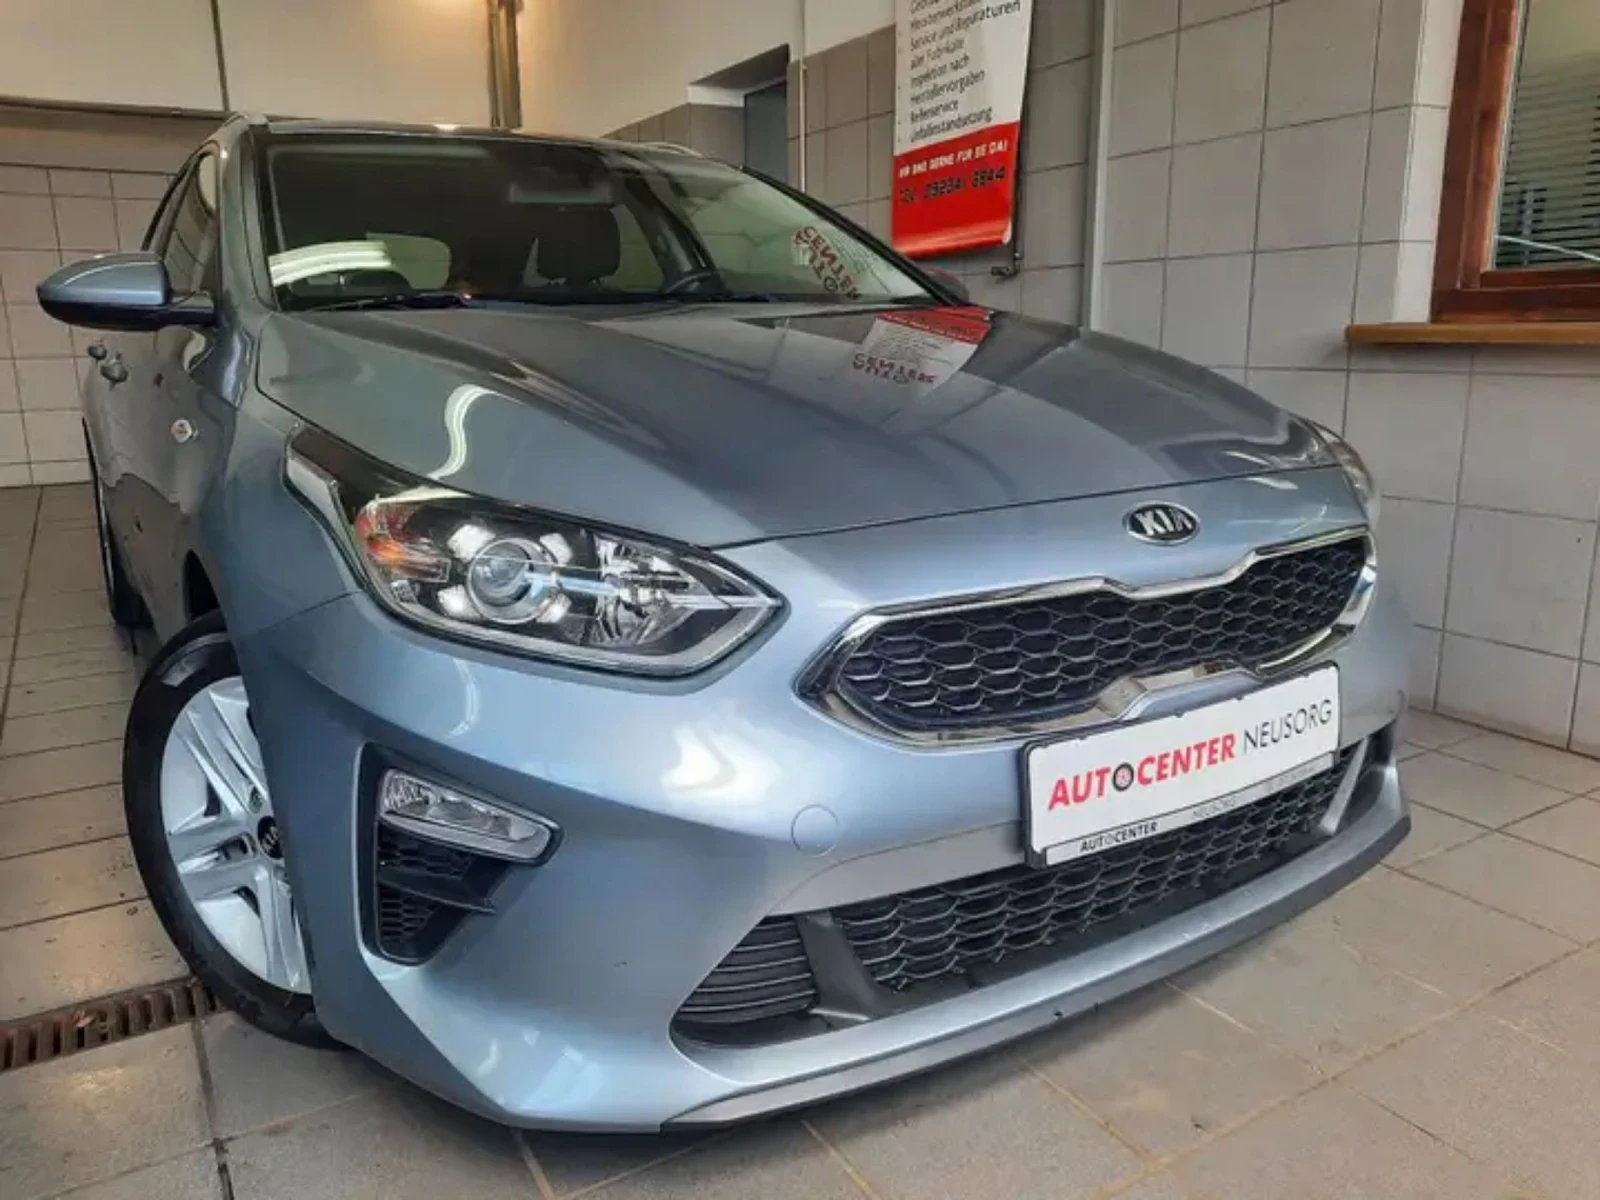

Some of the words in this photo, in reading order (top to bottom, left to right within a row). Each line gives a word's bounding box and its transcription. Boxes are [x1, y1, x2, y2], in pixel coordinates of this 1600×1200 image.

[1135, 508, 1193, 536] KIA
[1243, 699, 1333, 754] NEUSORG
[1079, 821, 1159, 853] AUTOCENTER
